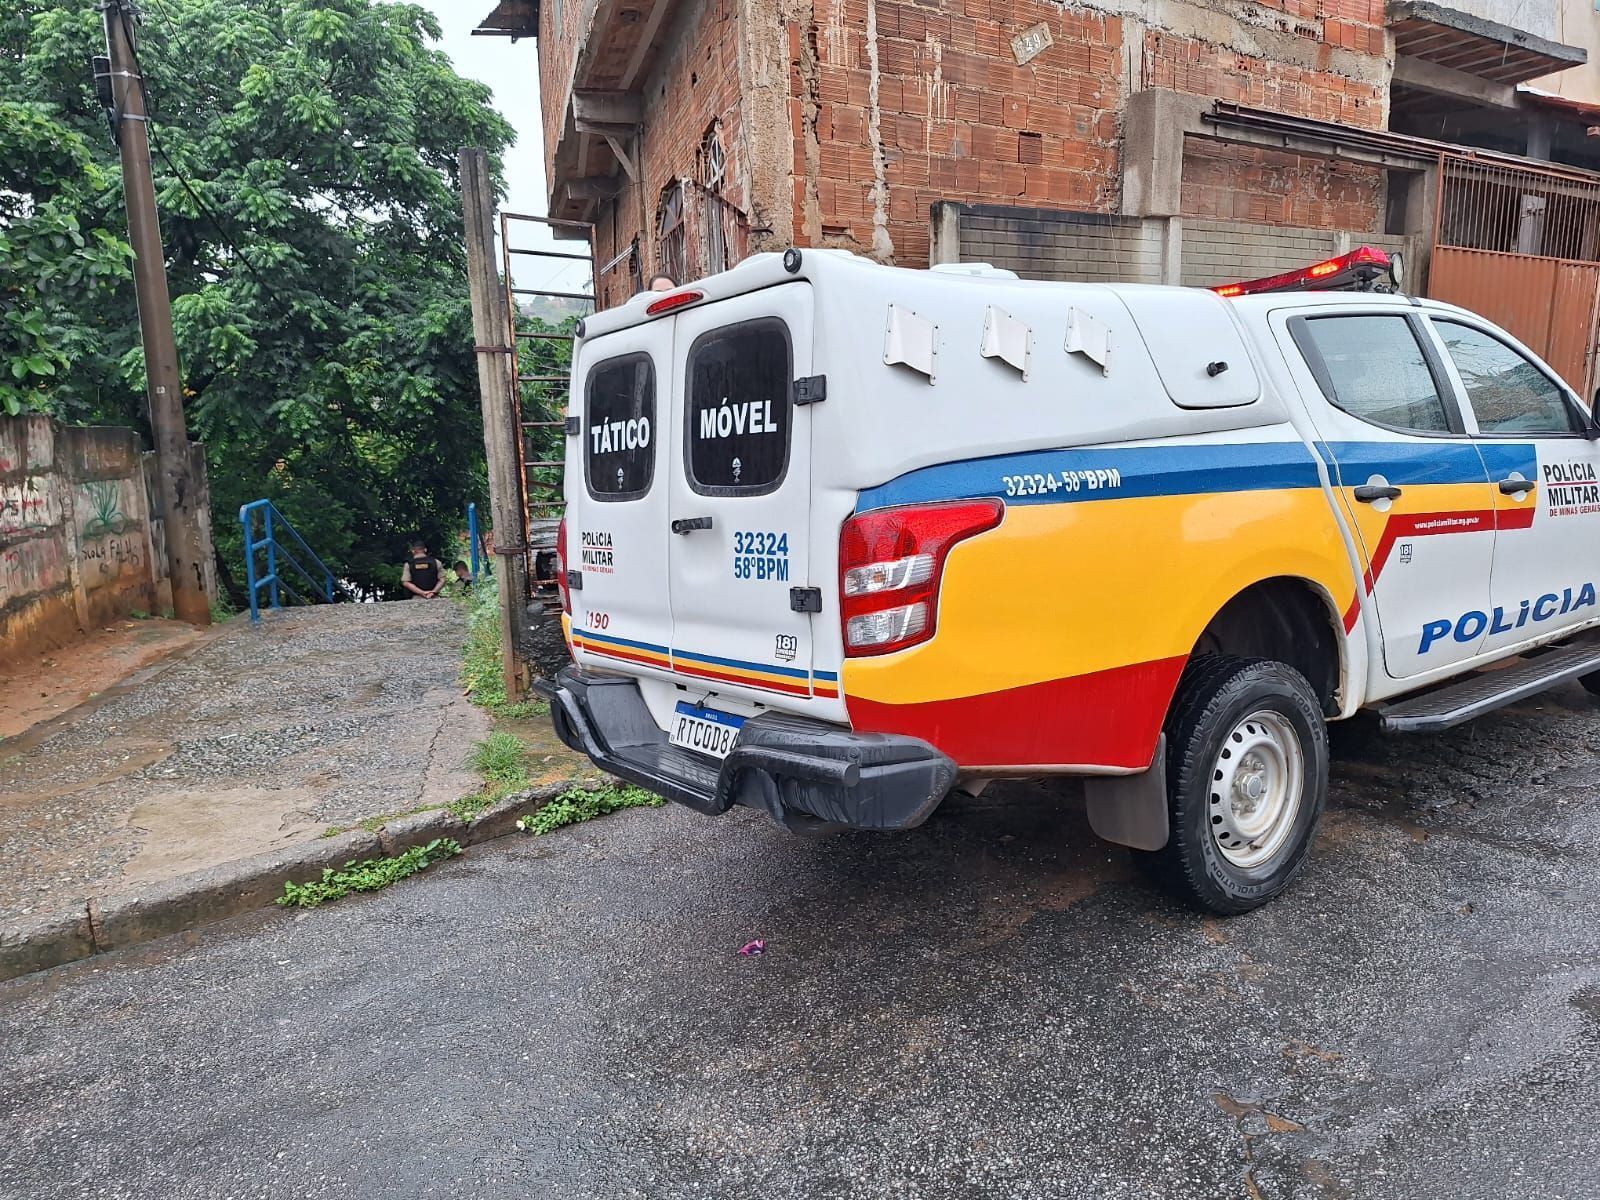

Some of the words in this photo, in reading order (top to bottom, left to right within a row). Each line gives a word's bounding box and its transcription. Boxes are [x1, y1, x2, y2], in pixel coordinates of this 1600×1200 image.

[700, 397, 777, 439] MÓVEL
[591, 416, 650, 454] TÁTICO
[1547, 485, 1600, 506] MILITAR
[1549, 508, 1558, 517] DE
[734, 531, 788, 557] 32324
[582, 550, 614, 567] MILITAR
[775, 634, 797, 651] 181
[1211, 861, 1262, 894] EVOLUTION
